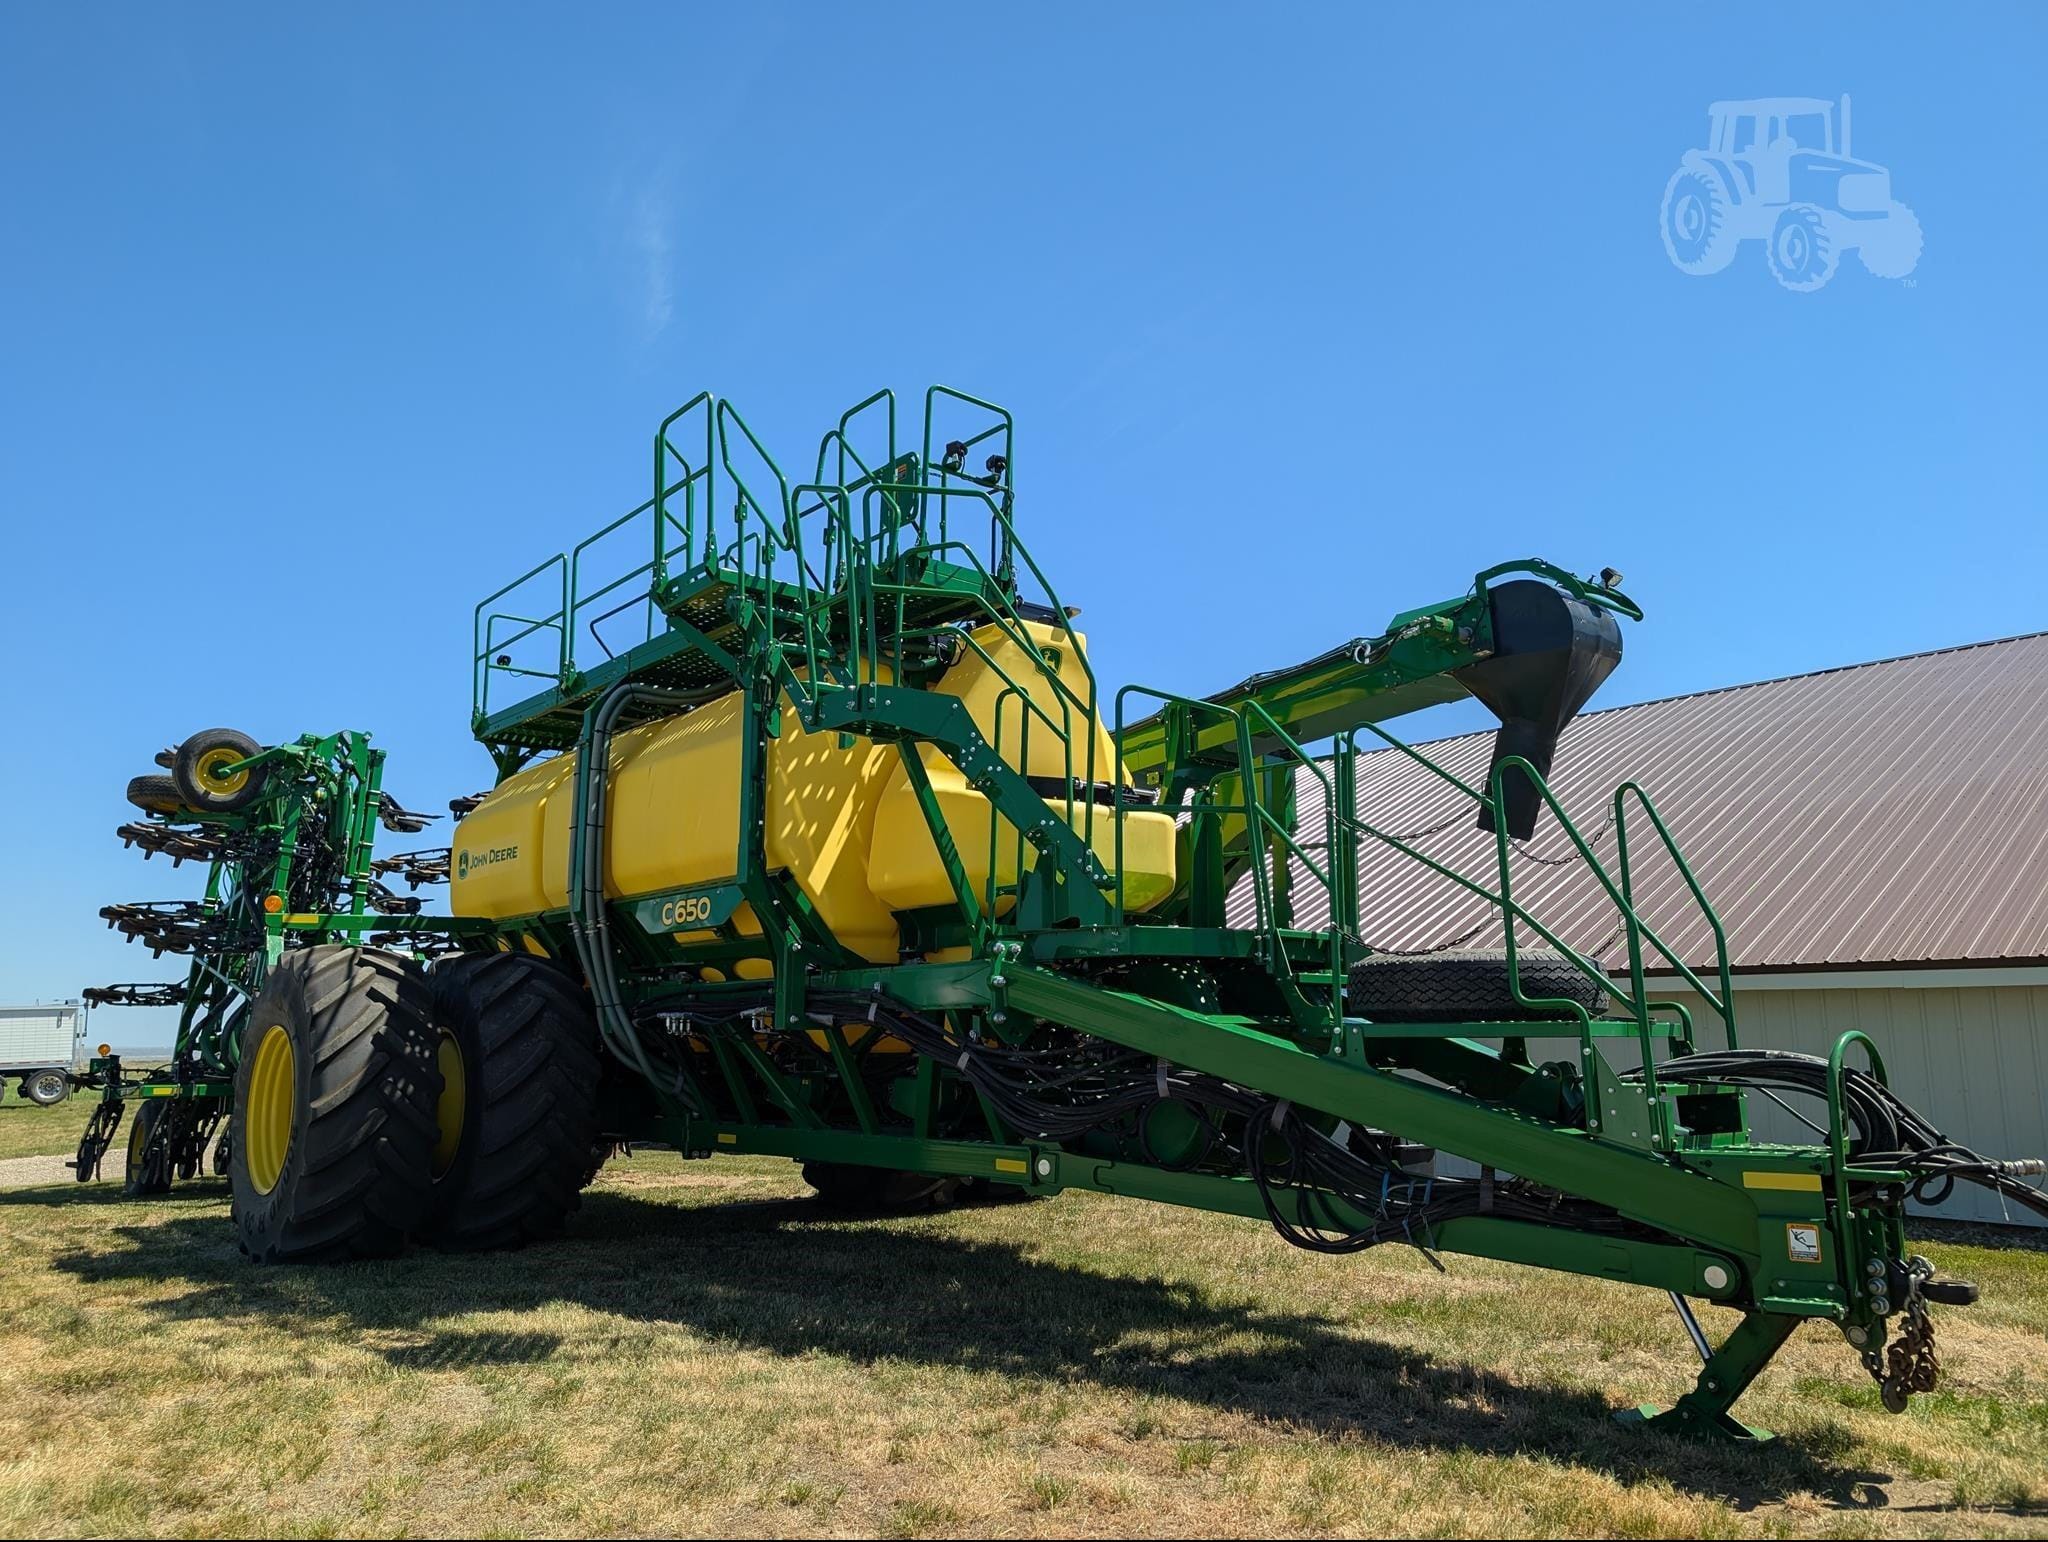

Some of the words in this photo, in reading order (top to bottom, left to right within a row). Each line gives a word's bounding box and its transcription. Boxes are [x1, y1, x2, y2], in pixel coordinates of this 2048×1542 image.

[470, 853, 488, 870] JOHN
[489, 846, 518, 864] DEERE
[662, 896, 711, 926] C650
